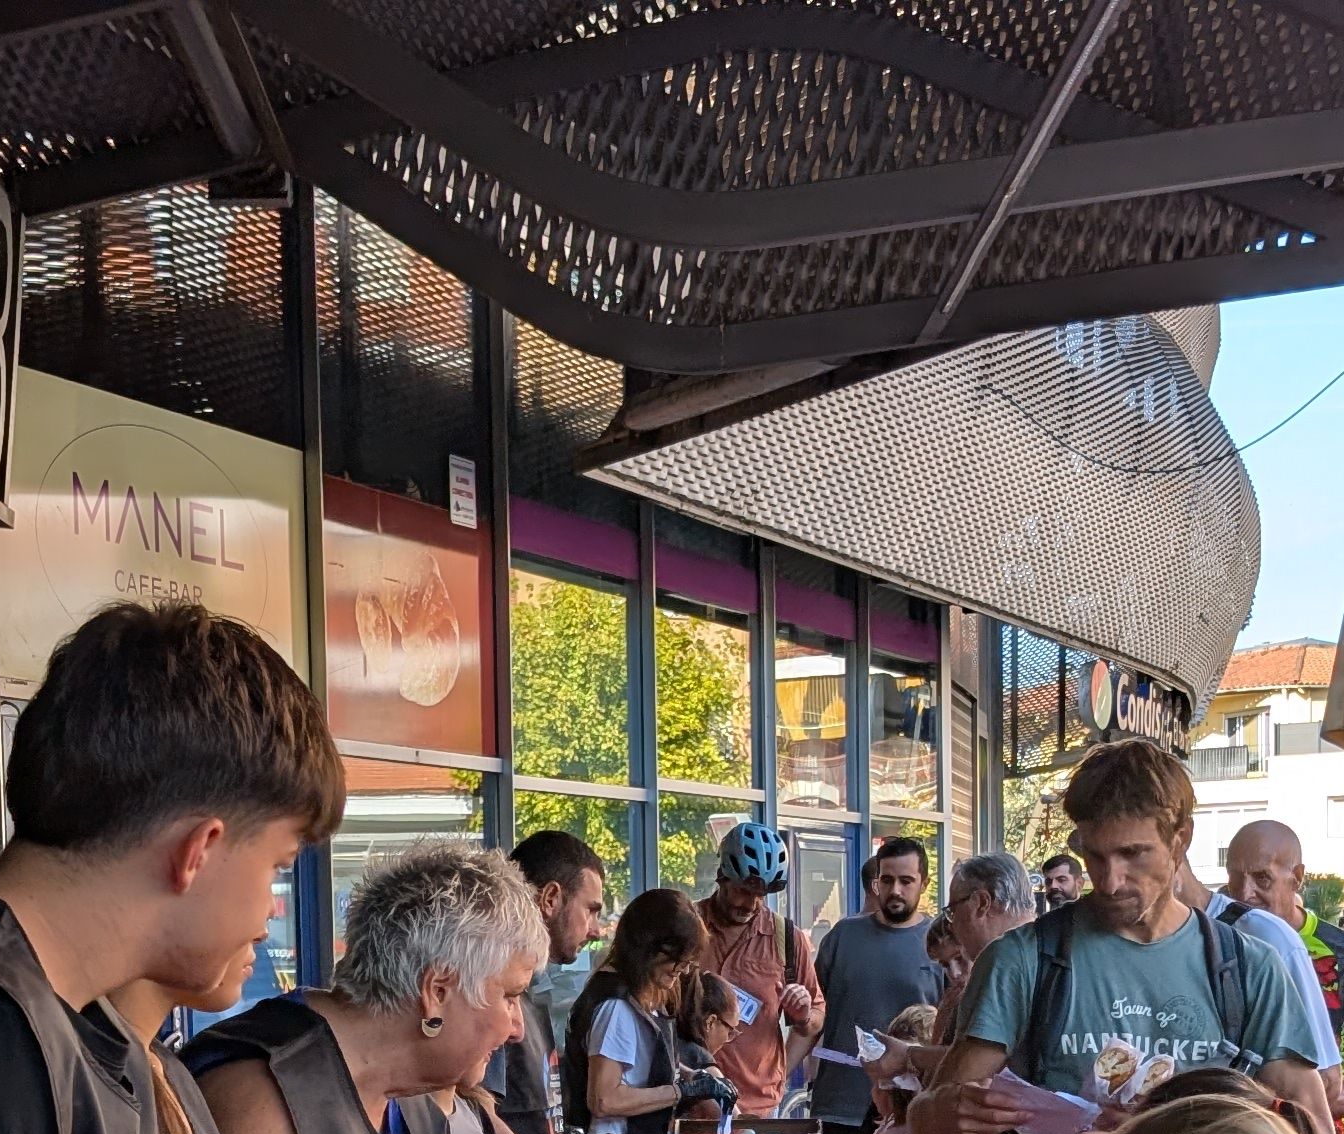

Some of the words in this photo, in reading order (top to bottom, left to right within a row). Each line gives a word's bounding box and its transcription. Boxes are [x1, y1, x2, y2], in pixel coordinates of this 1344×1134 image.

[72, 471, 245, 572] MANEL
[1110, 996, 1153, 1019] Town
[1156, 1011, 1178, 1028] of
